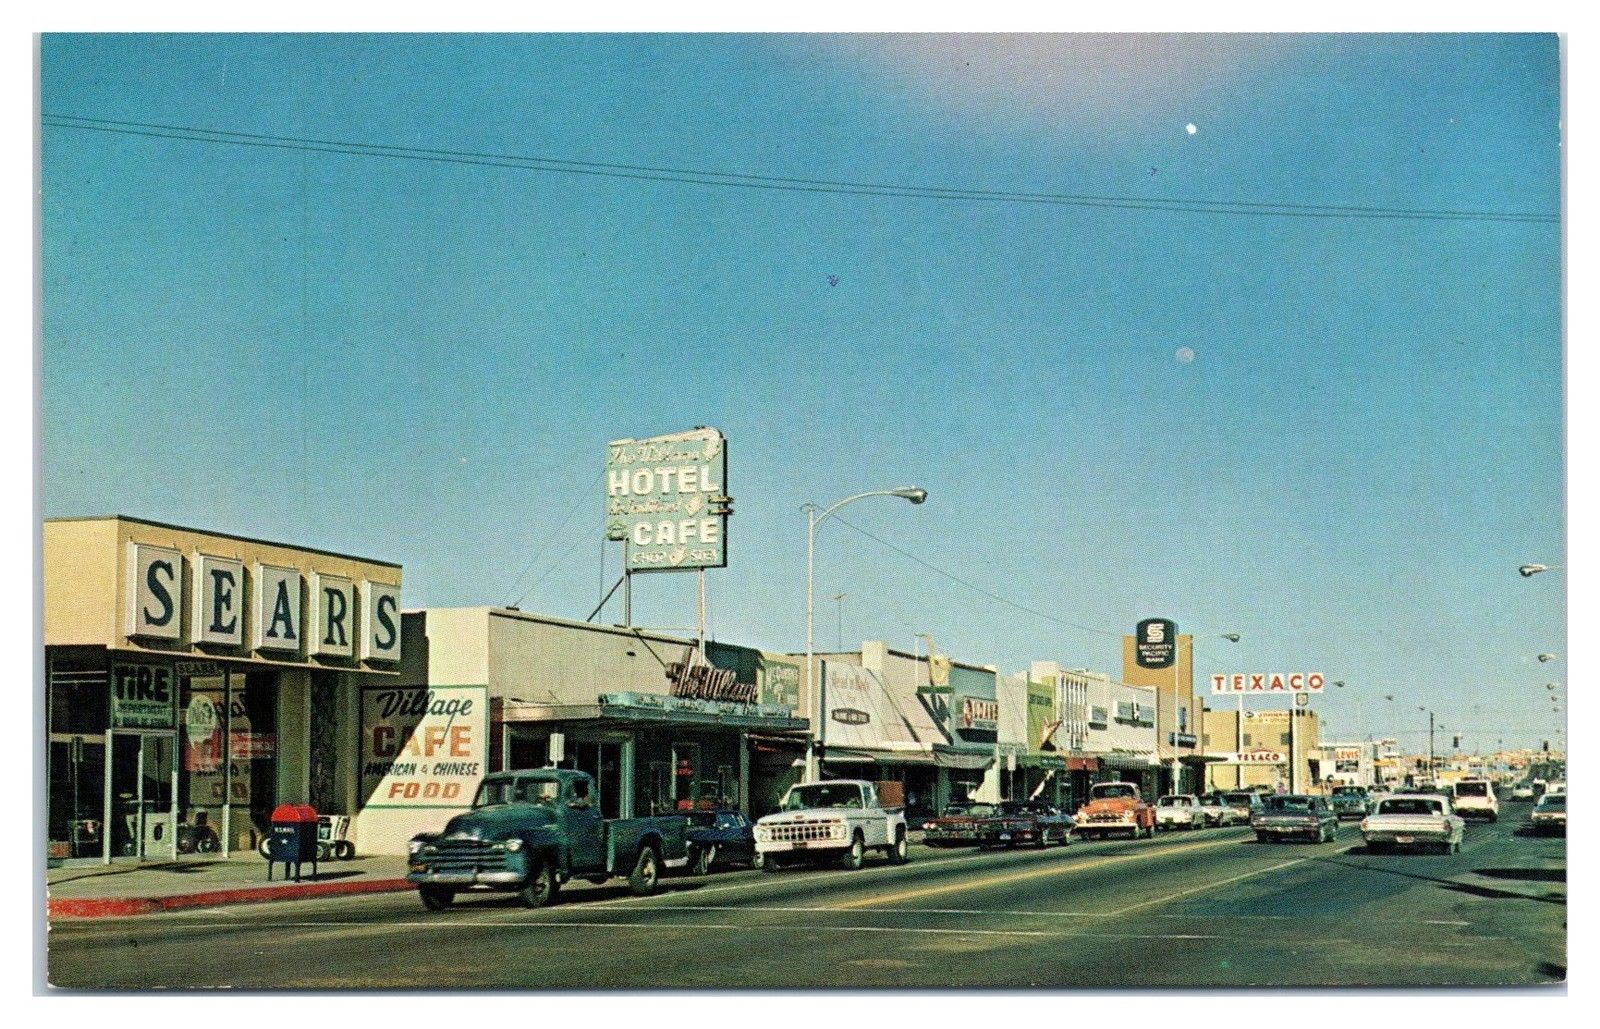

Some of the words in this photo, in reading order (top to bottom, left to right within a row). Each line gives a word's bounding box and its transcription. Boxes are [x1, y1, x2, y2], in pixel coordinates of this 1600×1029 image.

[608, 464, 720, 497] HOTEL
[633, 517, 719, 546] CAFE
[143, 559, 397, 651] SEARS
[1213, 674, 1324, 691] TEXACO
[376, 690, 473, 748] Village
[373, 725, 472, 758] CAFE
[363, 762, 418, 776] AMERICAN
[420, 763, 428, 775] &
[432, 762, 480, 776] CHINESE
[1236, 753, 1280, 762] TEXACO
[388, 782, 461, 799] FOOD
